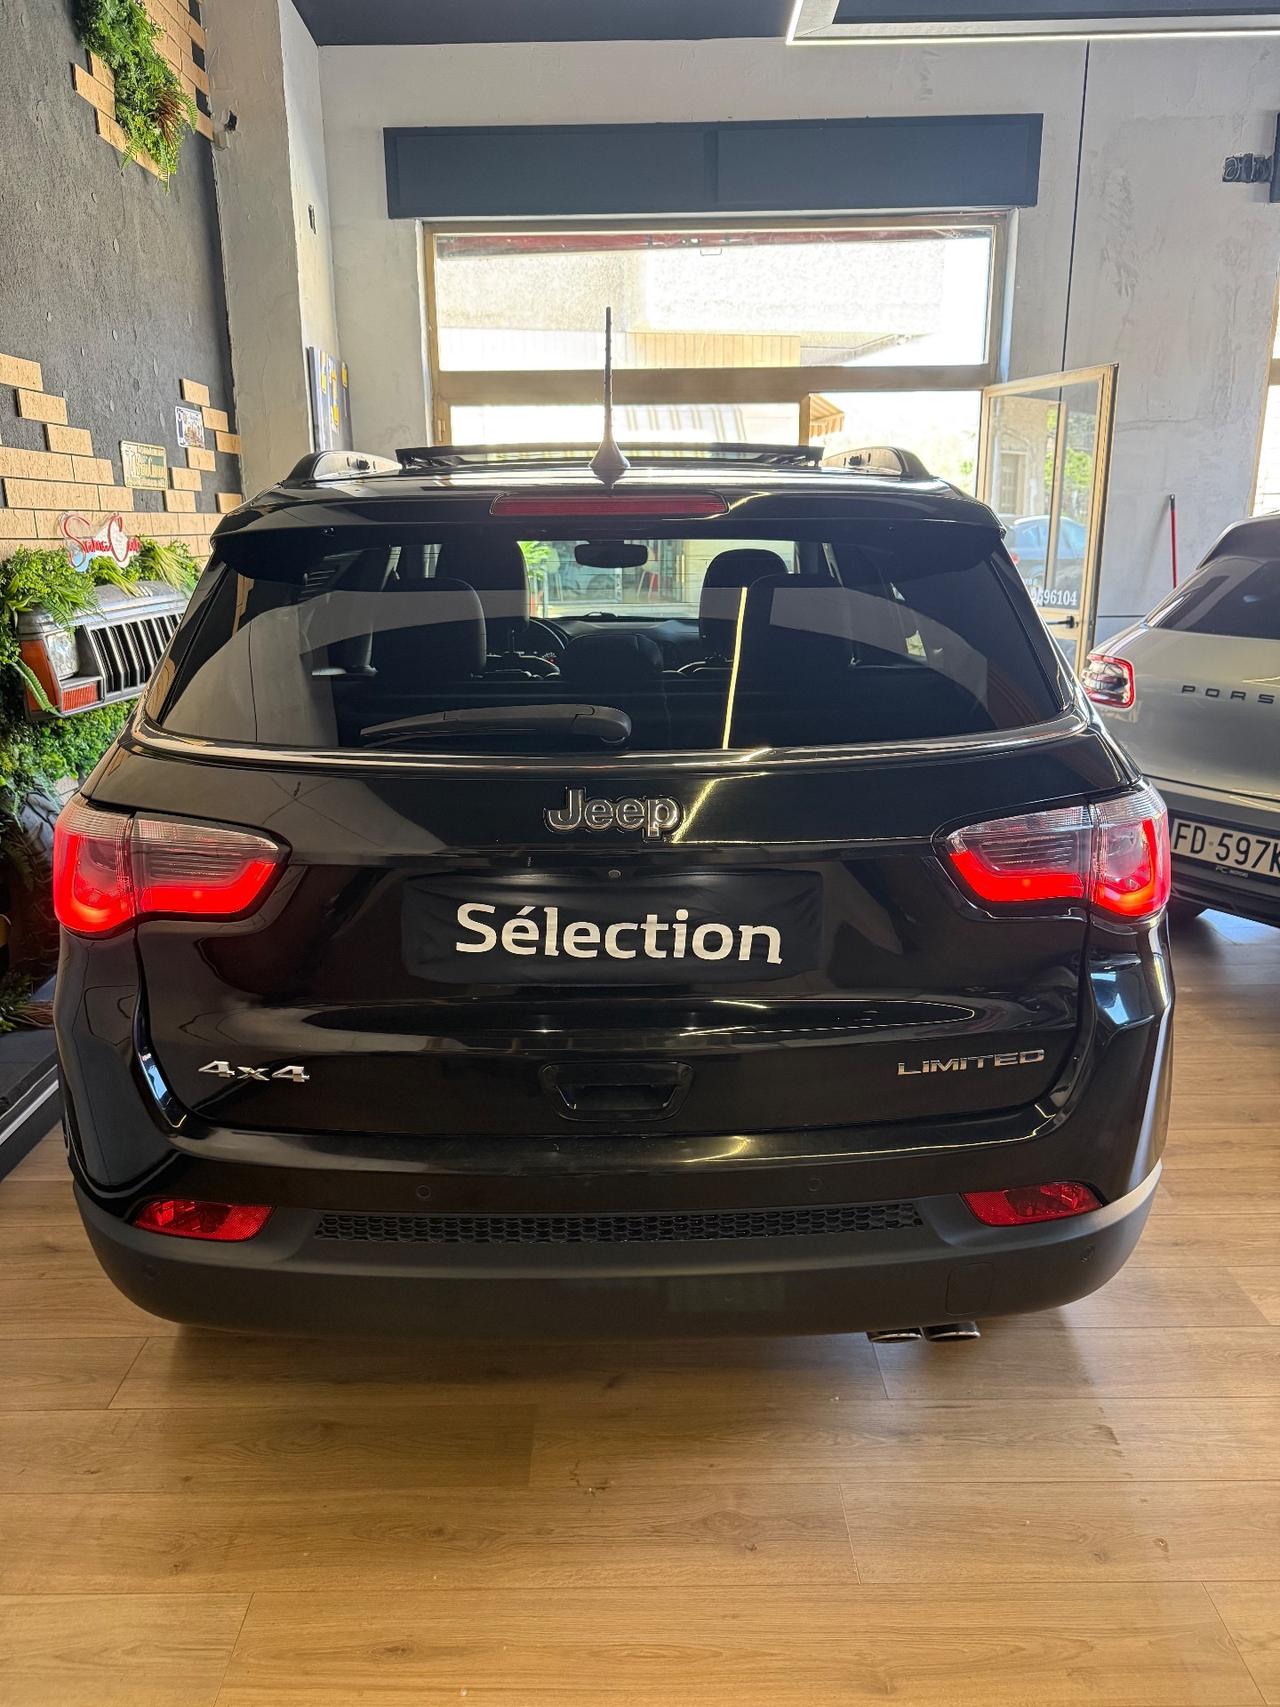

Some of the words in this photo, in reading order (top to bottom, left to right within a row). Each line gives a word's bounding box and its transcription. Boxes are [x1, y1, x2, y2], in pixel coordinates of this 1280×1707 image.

[1181, 685, 1275, 704] PORS
[546, 787, 681, 840] Jeep
[455, 902, 783, 965] Sélection
[198, 1060, 310, 1082] 4x4
[898, 1049, 1045, 1076] LIMITED
